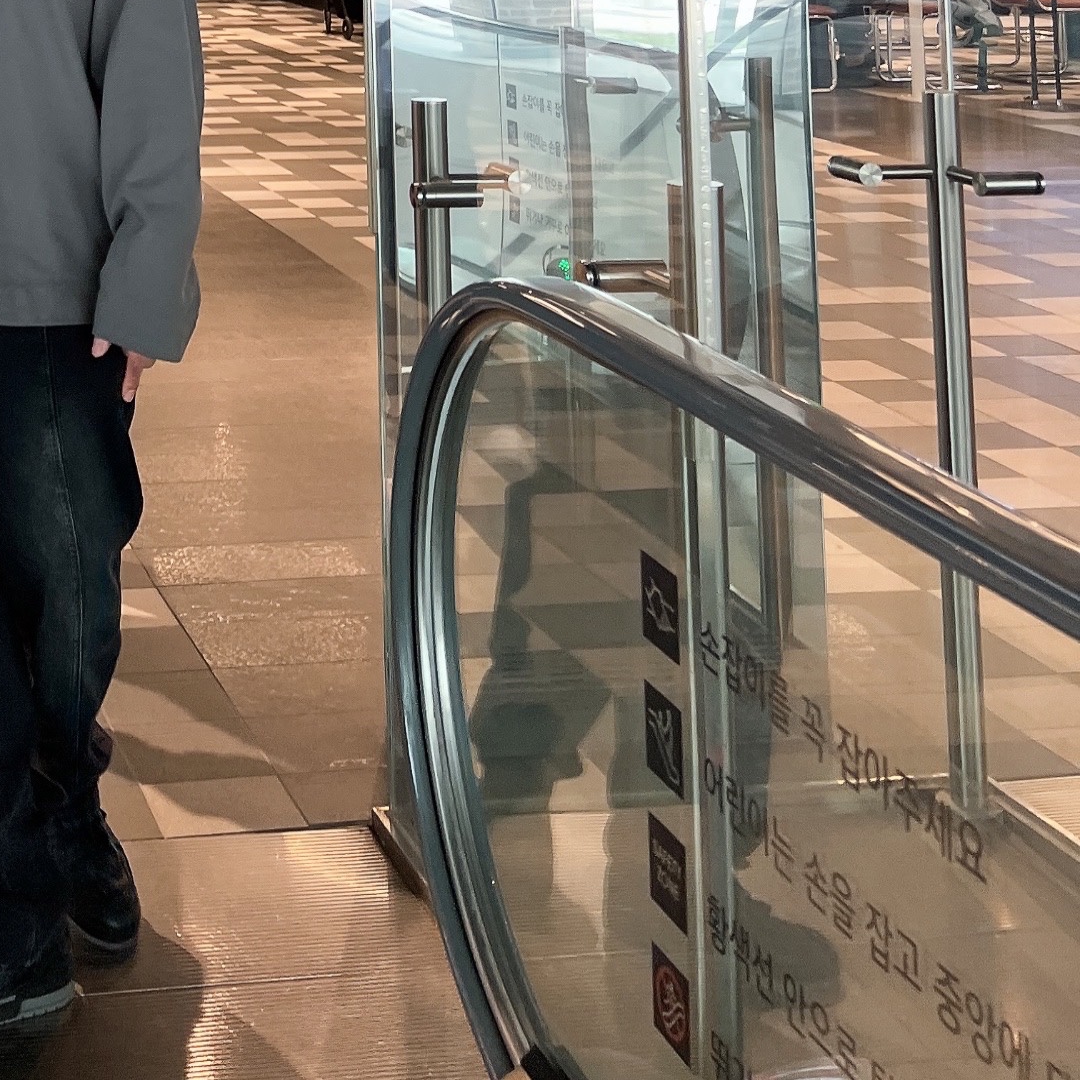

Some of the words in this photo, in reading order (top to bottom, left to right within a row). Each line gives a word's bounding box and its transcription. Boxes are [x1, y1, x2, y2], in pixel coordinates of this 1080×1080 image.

[699, 620, 792, 735] 손잡이를
[801, 695, 828, 763] 꼭
[836, 723, 987, 885] 잡아주세요
[703, 756, 795, 883] 어린이는
[804, 853, 856, 940] 손을
[866, 902, 923, 993] 잡고
[933, 962, 1031, 1080] 중앙에
[784, 972, 857, 1080] 안으로
